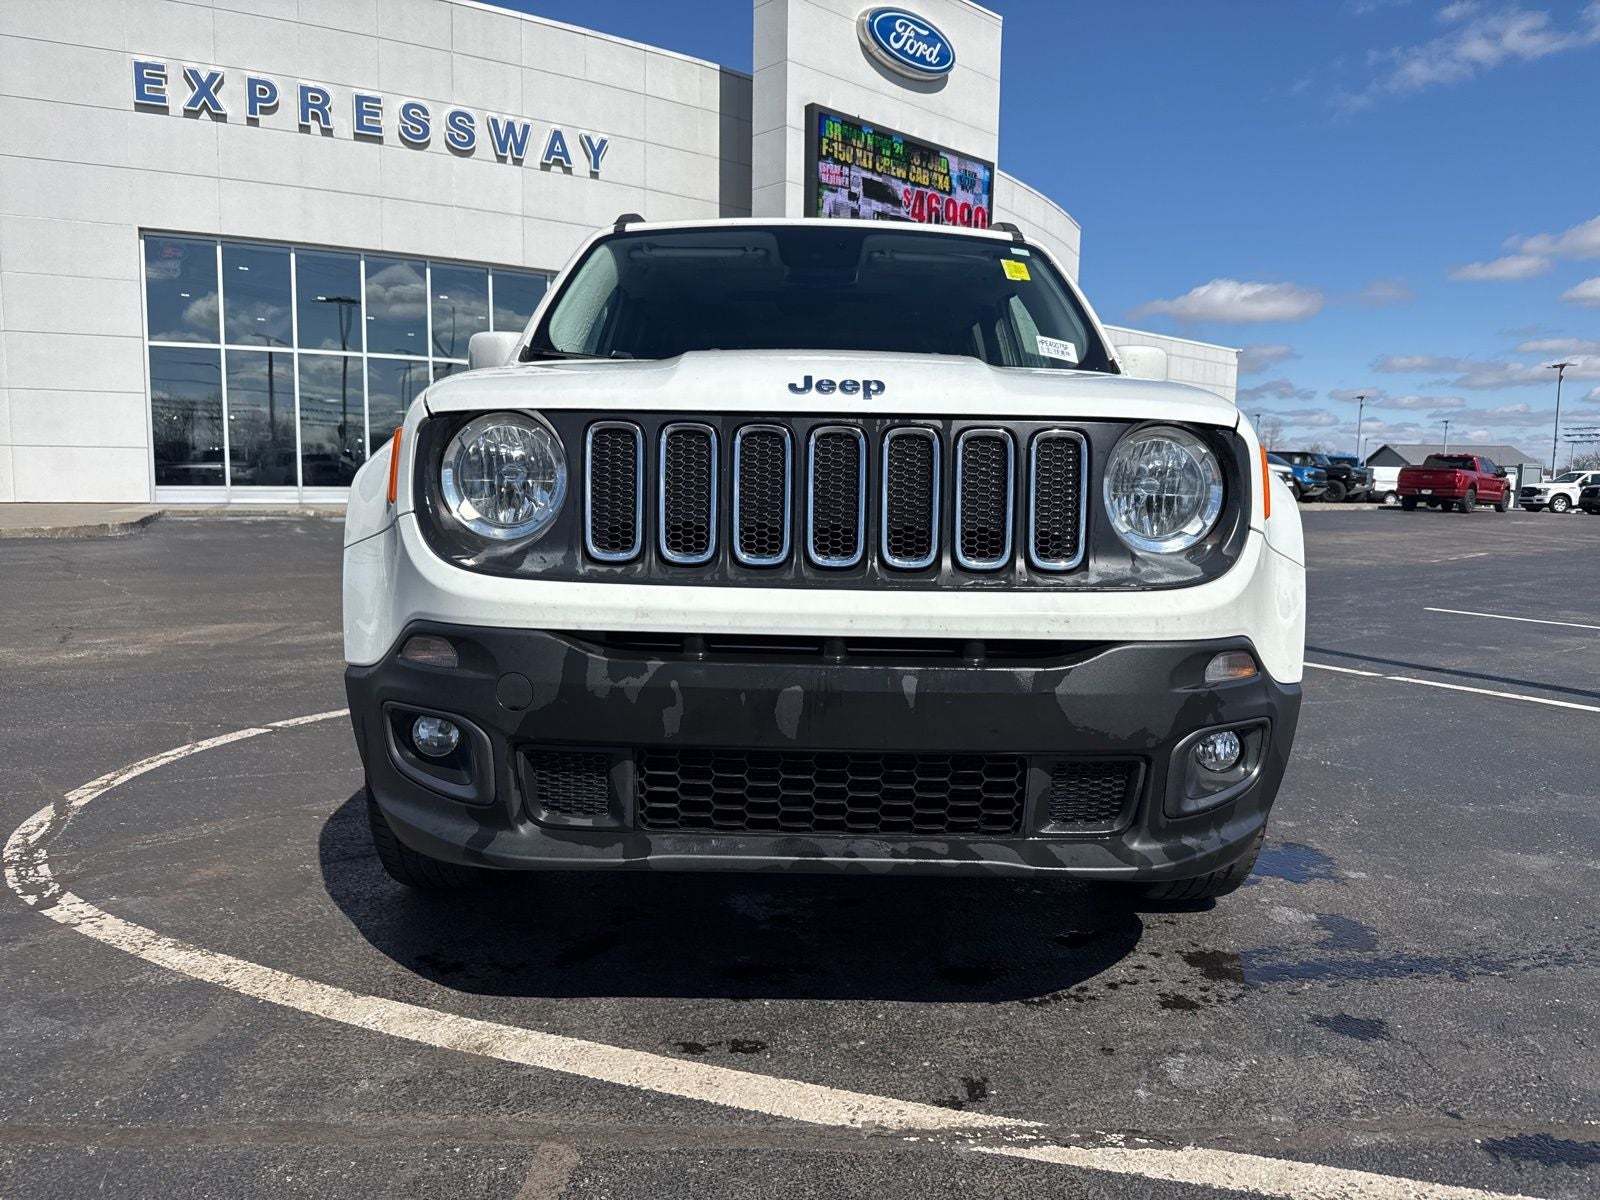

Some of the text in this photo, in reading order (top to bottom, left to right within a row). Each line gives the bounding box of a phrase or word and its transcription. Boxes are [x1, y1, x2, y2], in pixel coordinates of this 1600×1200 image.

[889, 19, 942, 64] Ford
[132, 59, 610, 176] EXPRESSWAY
[787, 375, 886, 400] Jeep
